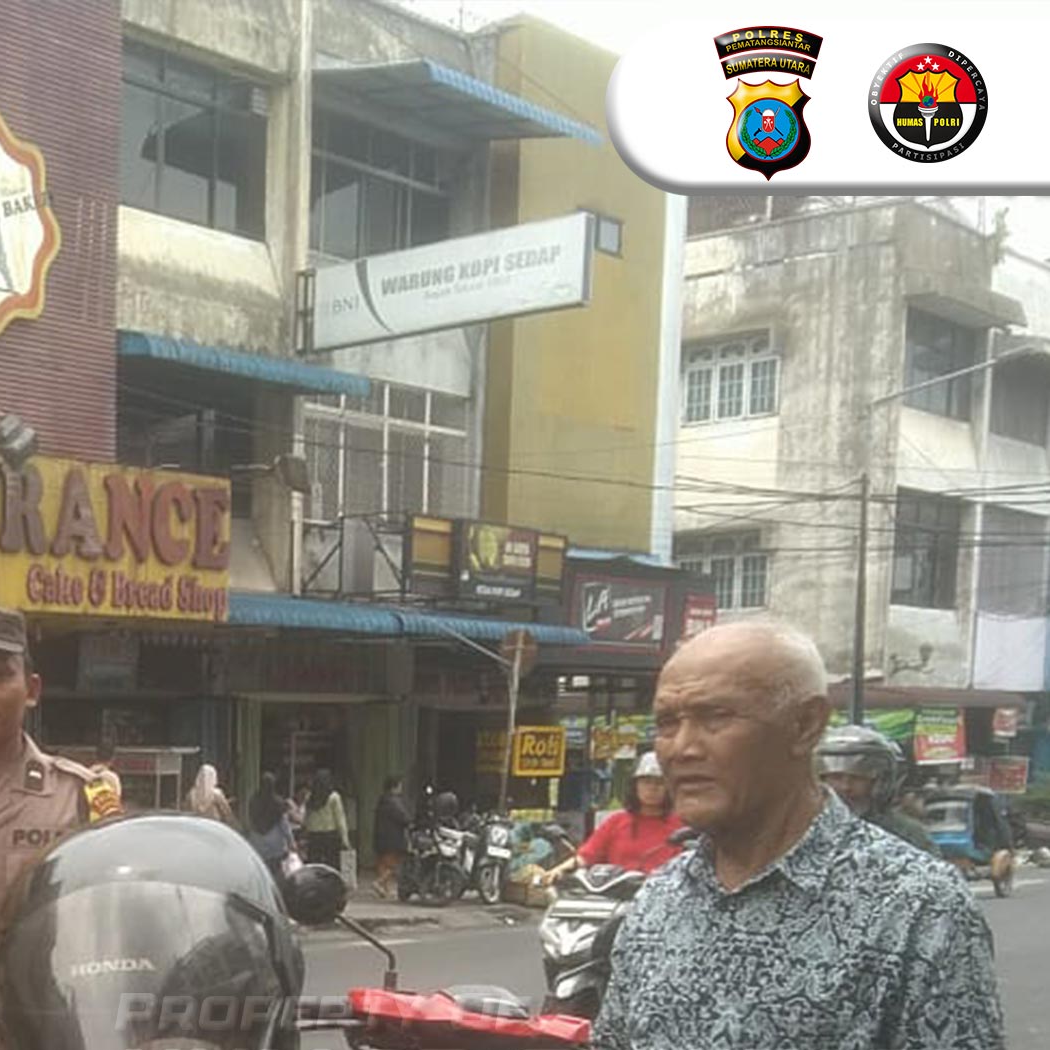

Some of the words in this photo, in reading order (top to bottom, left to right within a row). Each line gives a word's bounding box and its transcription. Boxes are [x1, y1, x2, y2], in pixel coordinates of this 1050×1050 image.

[381, 264, 455, 297] WARUNG
[458, 255, 499, 281] KOPI
[503, 244, 561, 273] SEDAP
[26, 563, 83, 605] Cake
[110, 569, 173, 612] Bread
[176, 574, 227, 622] Shop
[522, 732, 560, 757] Roti
[71, 958, 157, 979] HONDA
